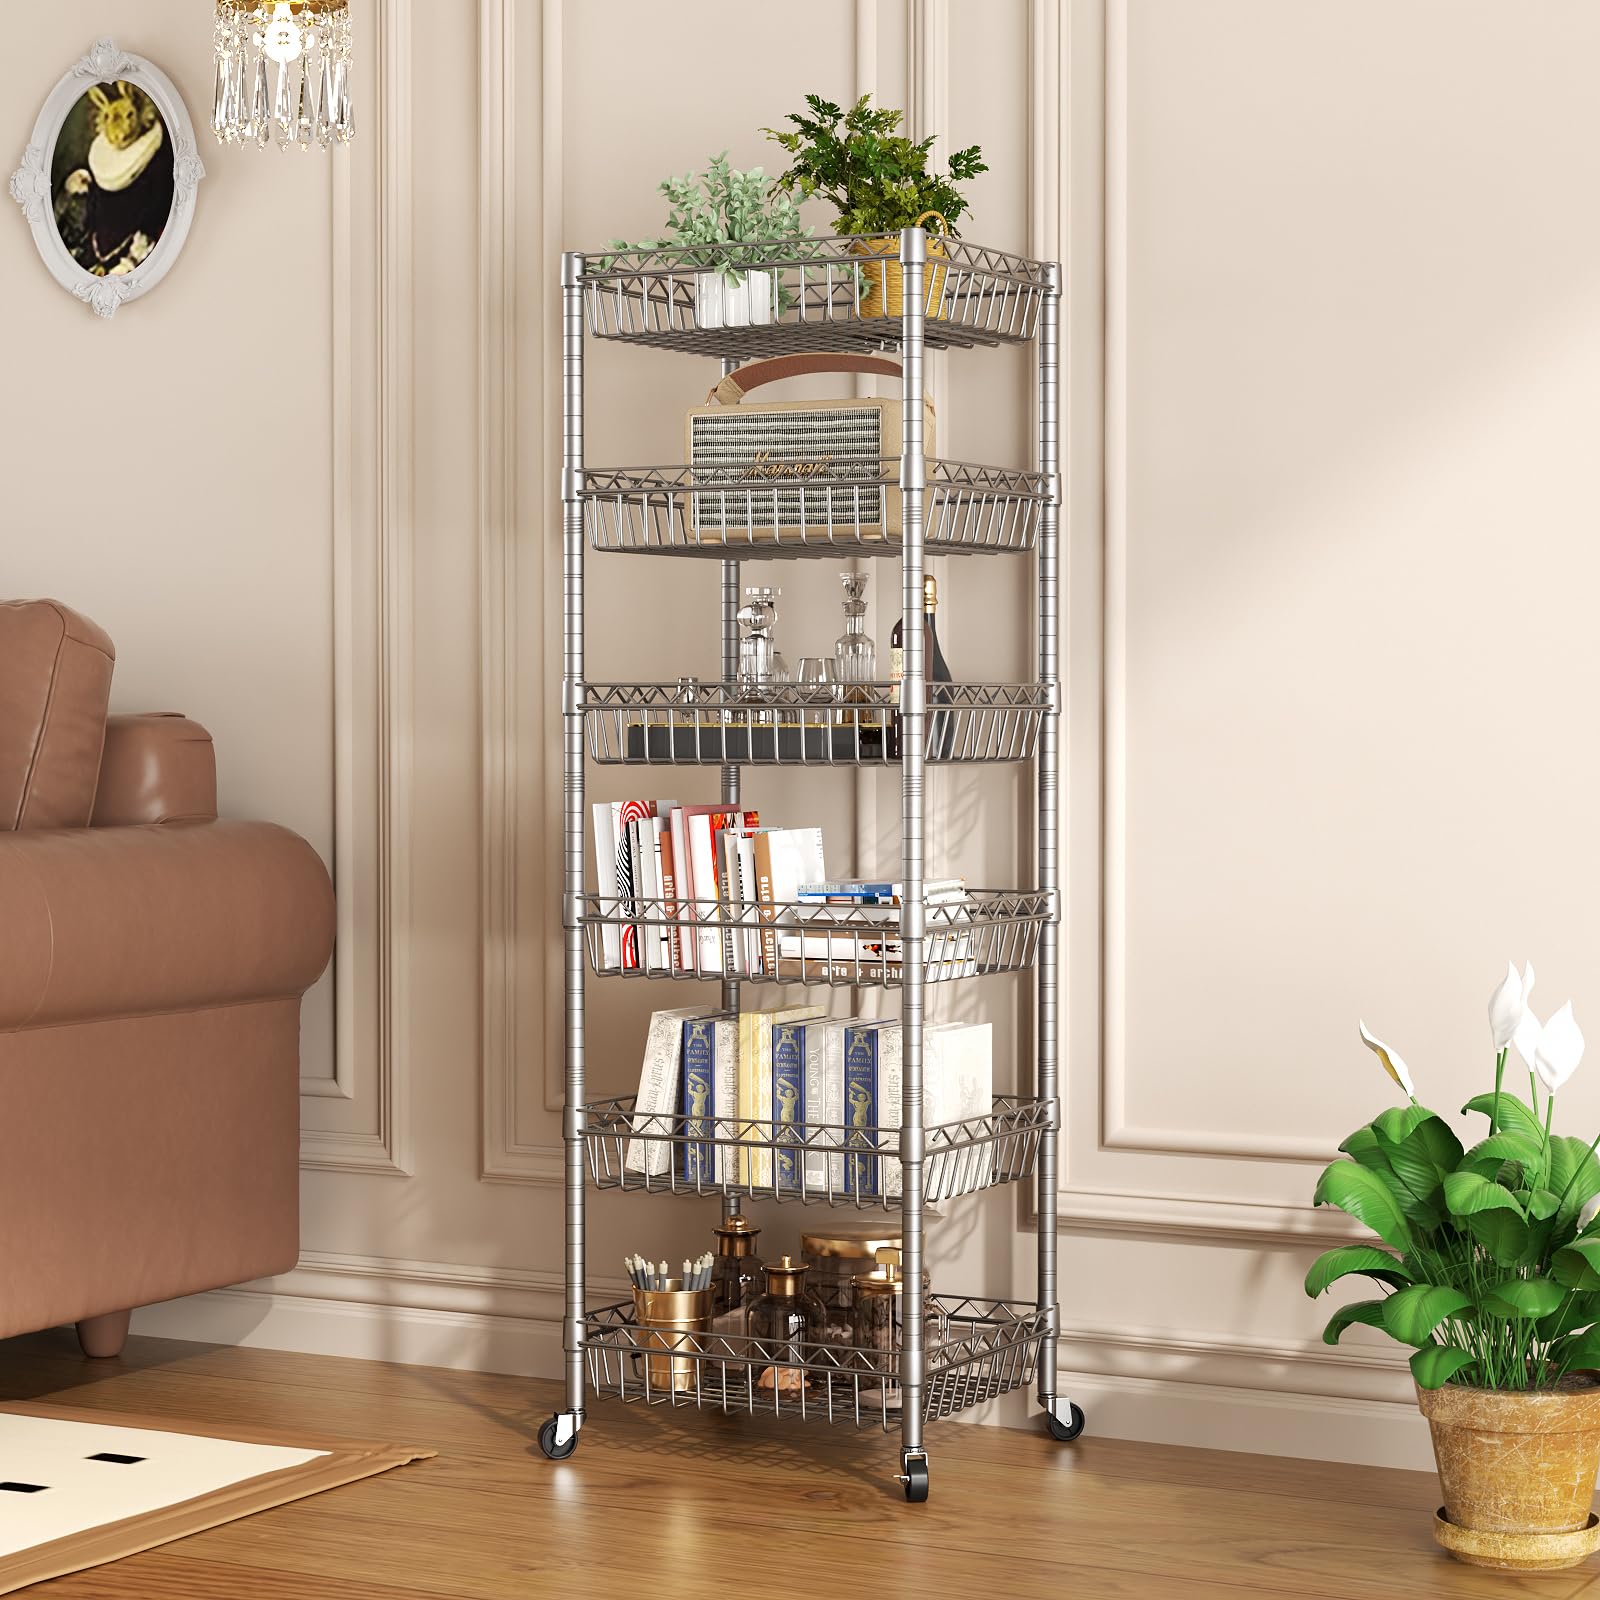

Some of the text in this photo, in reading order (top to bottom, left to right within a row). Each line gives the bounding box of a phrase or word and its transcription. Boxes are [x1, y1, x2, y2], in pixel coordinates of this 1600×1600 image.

[664, 875, 675, 898] arts
[809, 1048, 820, 1086] YOUNG
[808, 1098, 821, 1119] THE
